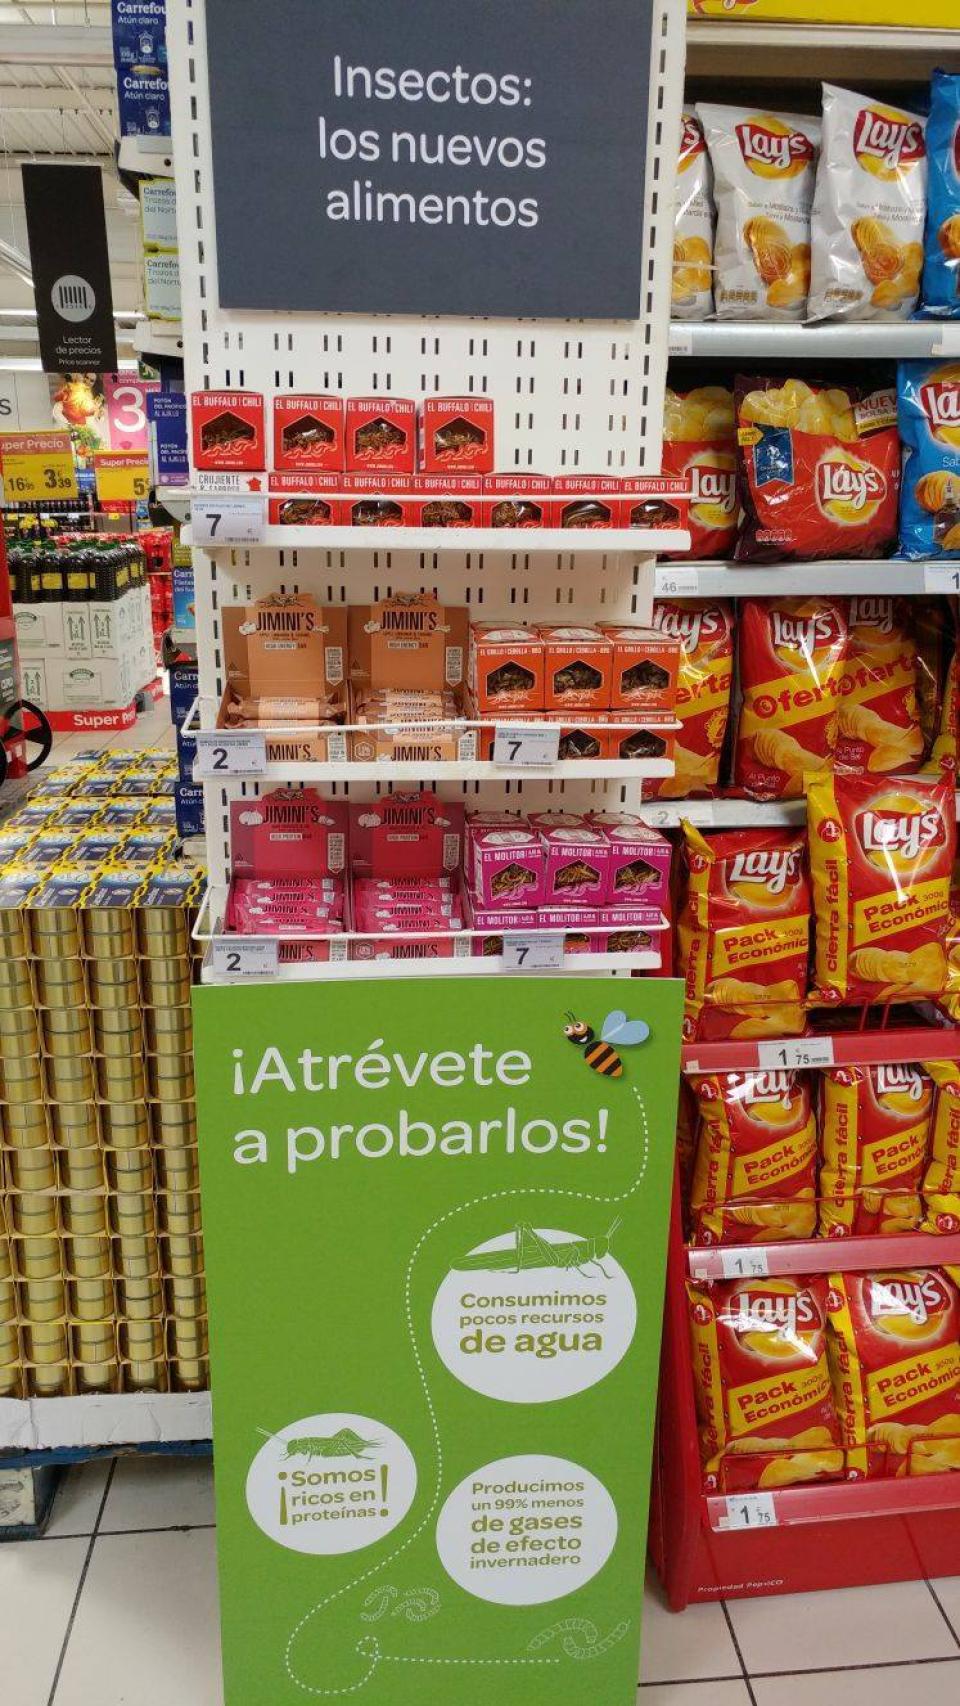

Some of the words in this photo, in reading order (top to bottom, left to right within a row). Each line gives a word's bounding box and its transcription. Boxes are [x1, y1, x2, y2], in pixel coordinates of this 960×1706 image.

[334, 55, 532, 107] Insectos:
[319, 117, 380, 161] los
[392, 131, 546, 169] nuevos
[326, 181, 540, 228] alimentos
[63, 336, 92, 344] Lector
[56, 346, 68, 354] de
[193, 397, 201, 406] EL
[204, 397, 237, 407] BUFFALO
[243, 398, 262, 407] CHILI
[276, 400, 284, 410] EL
[286, 400, 319, 410] BUFFALO
[323, 401, 343, 411] CHILI
[348, 402, 356, 412] EL
[359, 402, 391, 413] BUFFALO
[395, 404, 414, 414] CHILI
[428, 403, 435, 412] EL
[438, 402, 469, 412] BUFFALO
[475, 403, 493, 412] CHILI
[27, 439, 65, 449] Precio
[100, 458, 125, 467] Super
[270, 477, 279, 486] EL
[282, 477, 313, 486] BUFFALO
[319, 477, 338, 486] CHILI
[344, 477, 351, 486] EL
[354, 477, 385, 487] BUFFALO
[392, 478, 410, 488] CHILI
[415, 479, 421, 488] EL
[425, 479, 456, 488] BUFFALO
[461, 480, 479, 489] CHILI
[485, 479, 492, 488] EL
[495, 479, 526, 489] BUFFALO
[531, 480, 549, 489] CHILI
[555, 480, 563, 489] EL
[565, 480, 596, 489] BUFFALO
[601, 481, 619, 490] CHILI
[625, 481, 632, 491] EL
[634, 481, 665, 491] BUFFALO
[670, 482, 687, 491] CHILI
[206, 514, 221, 536] 7
[256, 611, 315, 631] JIMINI'S
[381, 611, 437, 631] JIMINI'S
[74, 715, 119, 728] Super
[213, 748, 228, 770] 2
[391, 746, 442, 762] JIMINI'S
[508, 741, 522, 761] 7
[263, 805, 320, 823] JIMINI'S
[381, 807, 434, 825] JIMINI'S
[863, 811, 939, 859] Lay's
[484, 853, 492, 861] EL
[494, 851, 525, 861] MOLITOR
[551, 847, 559, 856] EL
[561, 848, 592, 857] MOLITOR
[613, 846, 619, 854] EL
[622, 846, 653, 856] MOLITOR
[825, 860, 839, 904] fácil
[864, 895, 920, 921] Pack
[477, 916, 485, 925] EL
[487, 915, 518, 925] MOLITOR
[539, 914, 547, 923] EL
[550, 913, 580, 923] MOLITOR
[602, 913, 609, 922] EL
[612, 912, 642, 921] MOLITOR
[723, 928, 778, 951] Pack
[827, 910, 839, 972] cierra
[391, 944, 438, 959] JIMINI'S
[516, 947, 529, 965] 7
[227, 953, 241, 971] 2
[778, 1049, 787, 1066] 1
[795, 1054, 809, 1065] 75
[232, 1038, 532, 1095] ¡Atrévete
[835, 1103, 847, 1147] fácil
[233, 1129, 267, 1164] a
[287, 1107, 609, 1174] probarlos!
[871, 1134, 920, 1163] Pack
[744, 1145, 795, 1173] Pack
[834, 1151, 847, 1208] cierra
[735, 1258, 743, 1274] 1
[752, 1265, 763, 1274] 75
[459, 1292, 607, 1309] Consumimos
[459, 1314, 518, 1329] pocos
[521, 1312, 604, 1325] recursos
[459, 1330, 506, 1354] de
[515, 1332, 602, 1359] agua
[877, 1363, 933, 1393] Pack
[736, 1381, 798, 1410] Pack
[291, 1468, 376, 1487] Somos
[472, 1480, 584, 1496] Producimos
[291, 1491, 344, 1506] ricos
[350, 1490, 376, 1502] en
[472, 1501, 491, 1511] un
[495, 1499, 528, 1510] 99%
[531, 1498, 585, 1509] menos
[292, 1507, 376, 1525] proteínas
[740, 1505, 749, 1524] 1
[758, 1513, 771, 1523] 75
[471, 1515, 503, 1532] de
[509, 1516, 582, 1538] gases
[471, 1537, 501, 1555] de
[505, 1535, 581, 1553] efecto
[470, 1554, 580, 1569] invernadero
